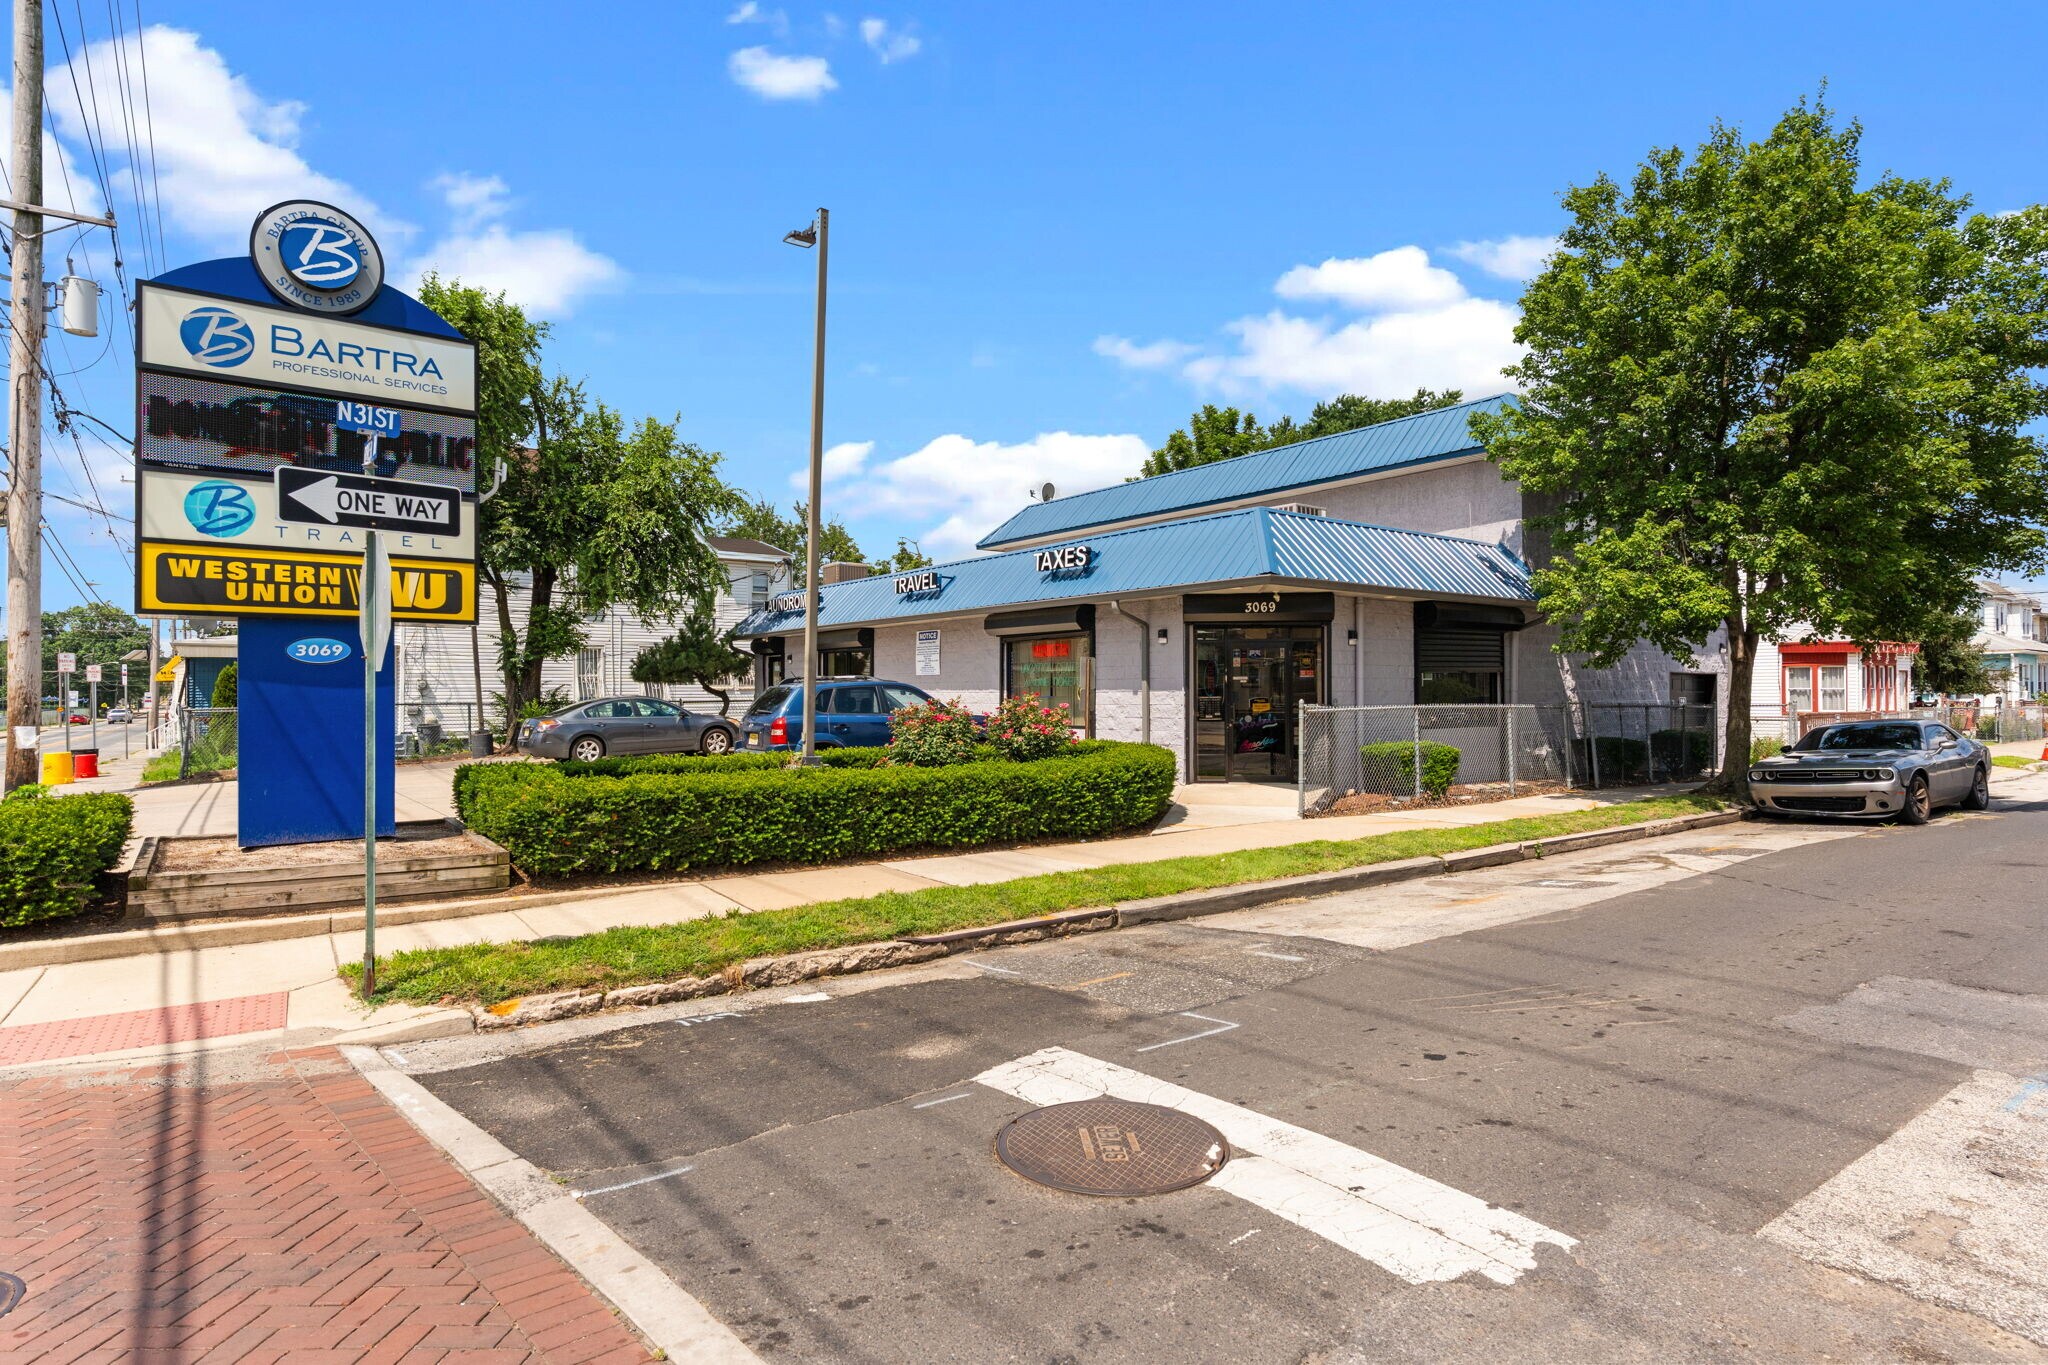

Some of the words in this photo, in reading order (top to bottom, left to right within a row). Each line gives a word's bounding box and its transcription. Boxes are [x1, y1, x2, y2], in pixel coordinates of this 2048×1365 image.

[276, 276, 322, 306] SINCE
[328, 289, 361, 307] 1989
[272, 360, 379, 384] PROFESSIONAL
[384, 377, 448, 395] SERVICES
[164, 462, 199, 470] VANTAGE
[337, 491, 386, 515] ONE
[395, 497, 443, 520] WAY
[274, 525, 442, 550] TRAEL
[168, 557, 341, 585] WESTERN
[1033, 545, 1087, 572] TAXES
[226, 581, 341, 605] UNION
[892, 572, 937, 594] TRAVEL
[1245, 601, 1276, 613] 3069
[295, 644, 343, 657] 3069
